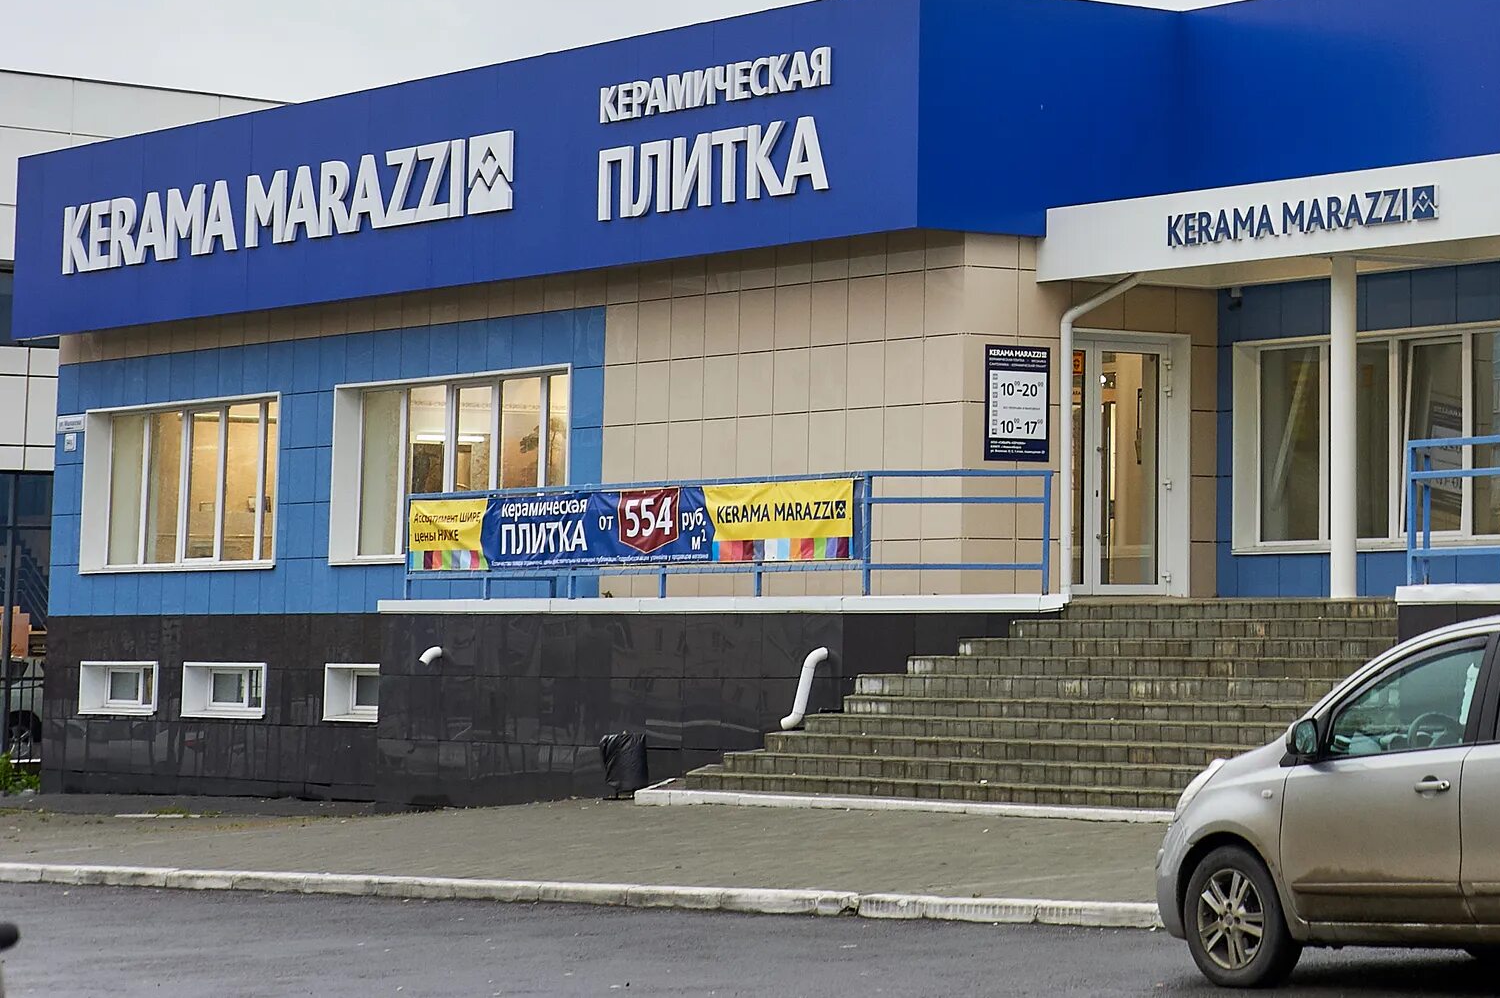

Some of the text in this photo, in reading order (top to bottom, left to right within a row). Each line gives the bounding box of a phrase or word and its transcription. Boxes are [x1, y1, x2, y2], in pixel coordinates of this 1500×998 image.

[600, 46, 832, 123] КЕРАМИЧЕСКАЯ
[598, 116, 829, 221] ПЛИТКА
[62, 139, 466, 274] KERAMA MARAZZI
[1167, 188, 1411, 248] KERAMA MARAZZI
[990, 349, 1014, 357] KERAMA
[502, 498, 588, 521] керамическая
[599, 496, 707, 538] от 554 руб.
[717, 501, 834, 523] KERAMA MARAZZI
[414, 532, 436, 543] цены
[501, 519, 588, 555] ПЛИТКА
